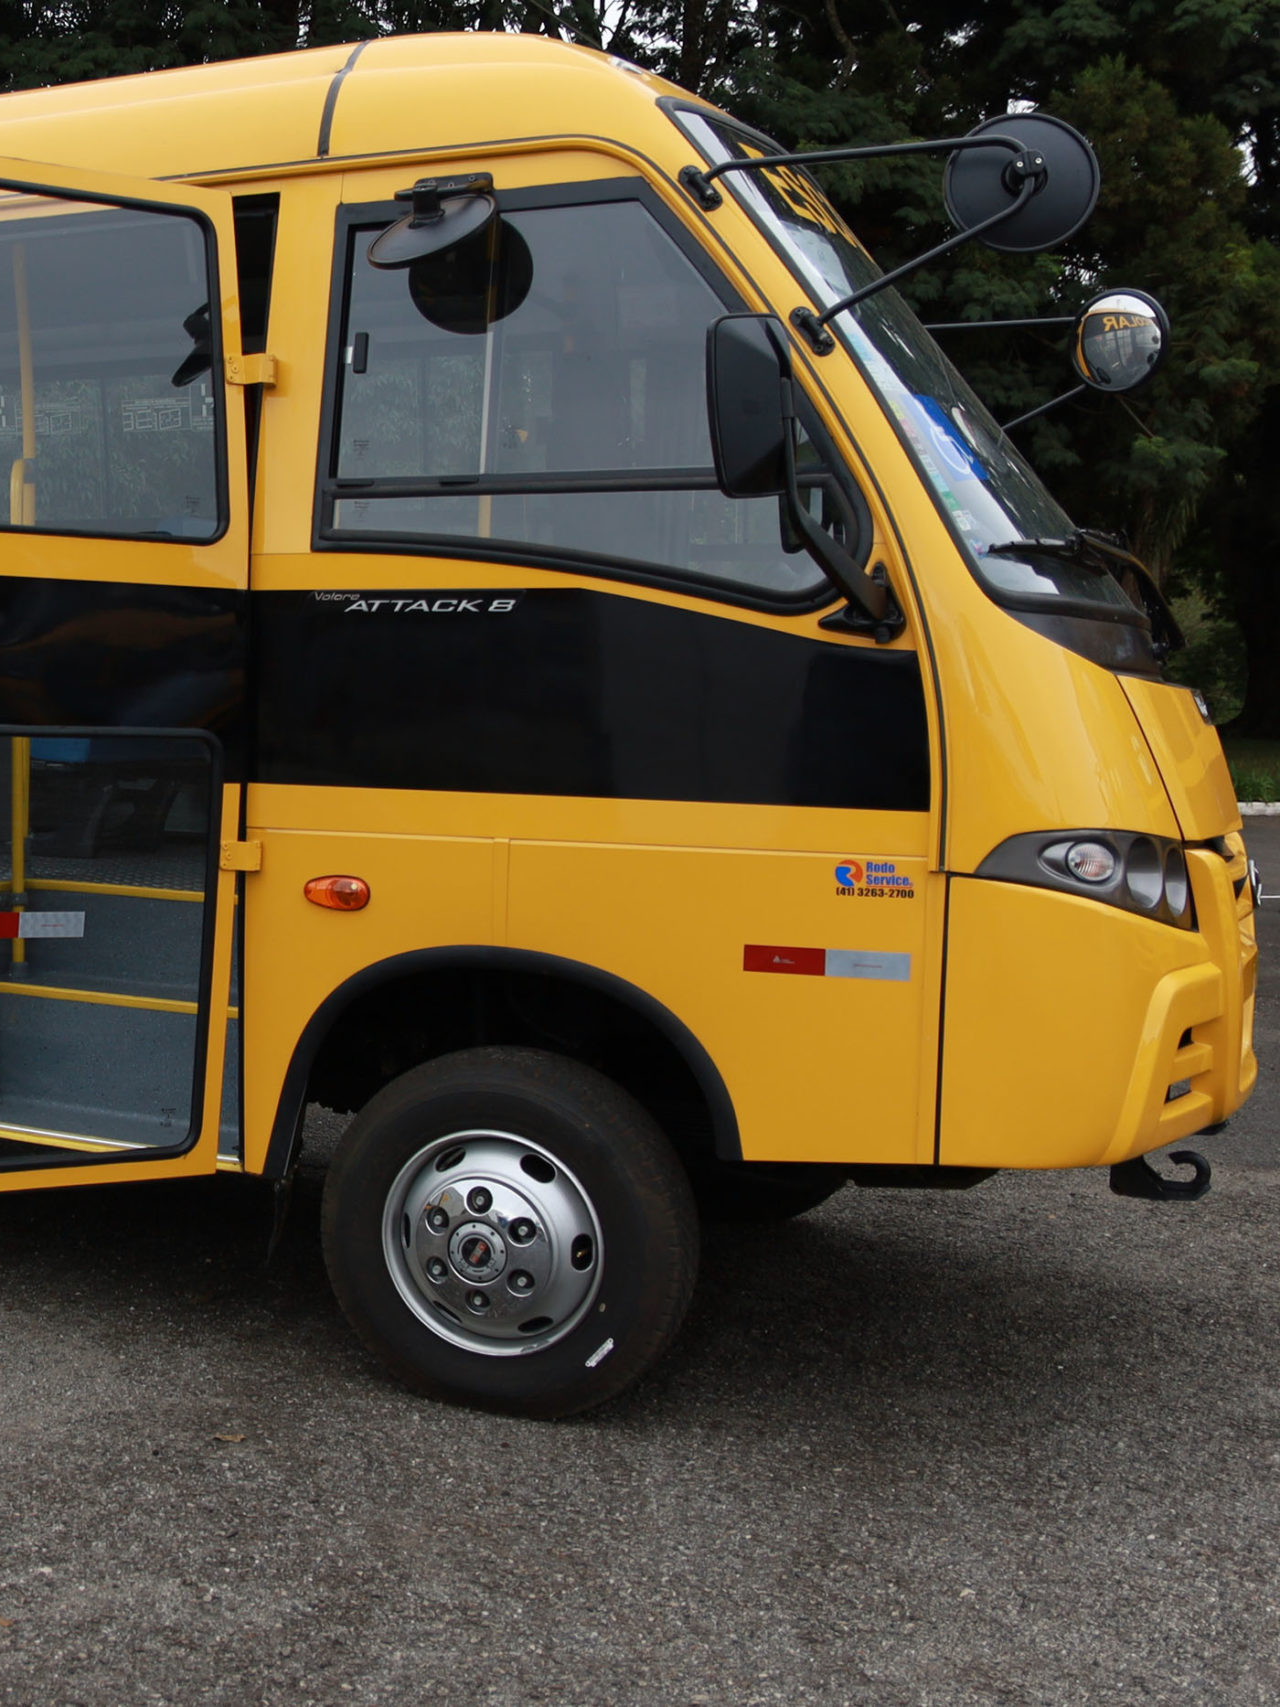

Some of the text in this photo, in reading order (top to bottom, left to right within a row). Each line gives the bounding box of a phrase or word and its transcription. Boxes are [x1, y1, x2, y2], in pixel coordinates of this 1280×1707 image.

[314, 591, 360, 601] Volare
[344, 599, 517, 613] ATTACK 8
[866, 861, 895, 873] Rodo
[836, 887, 915, 899] (41) 3263-2700
